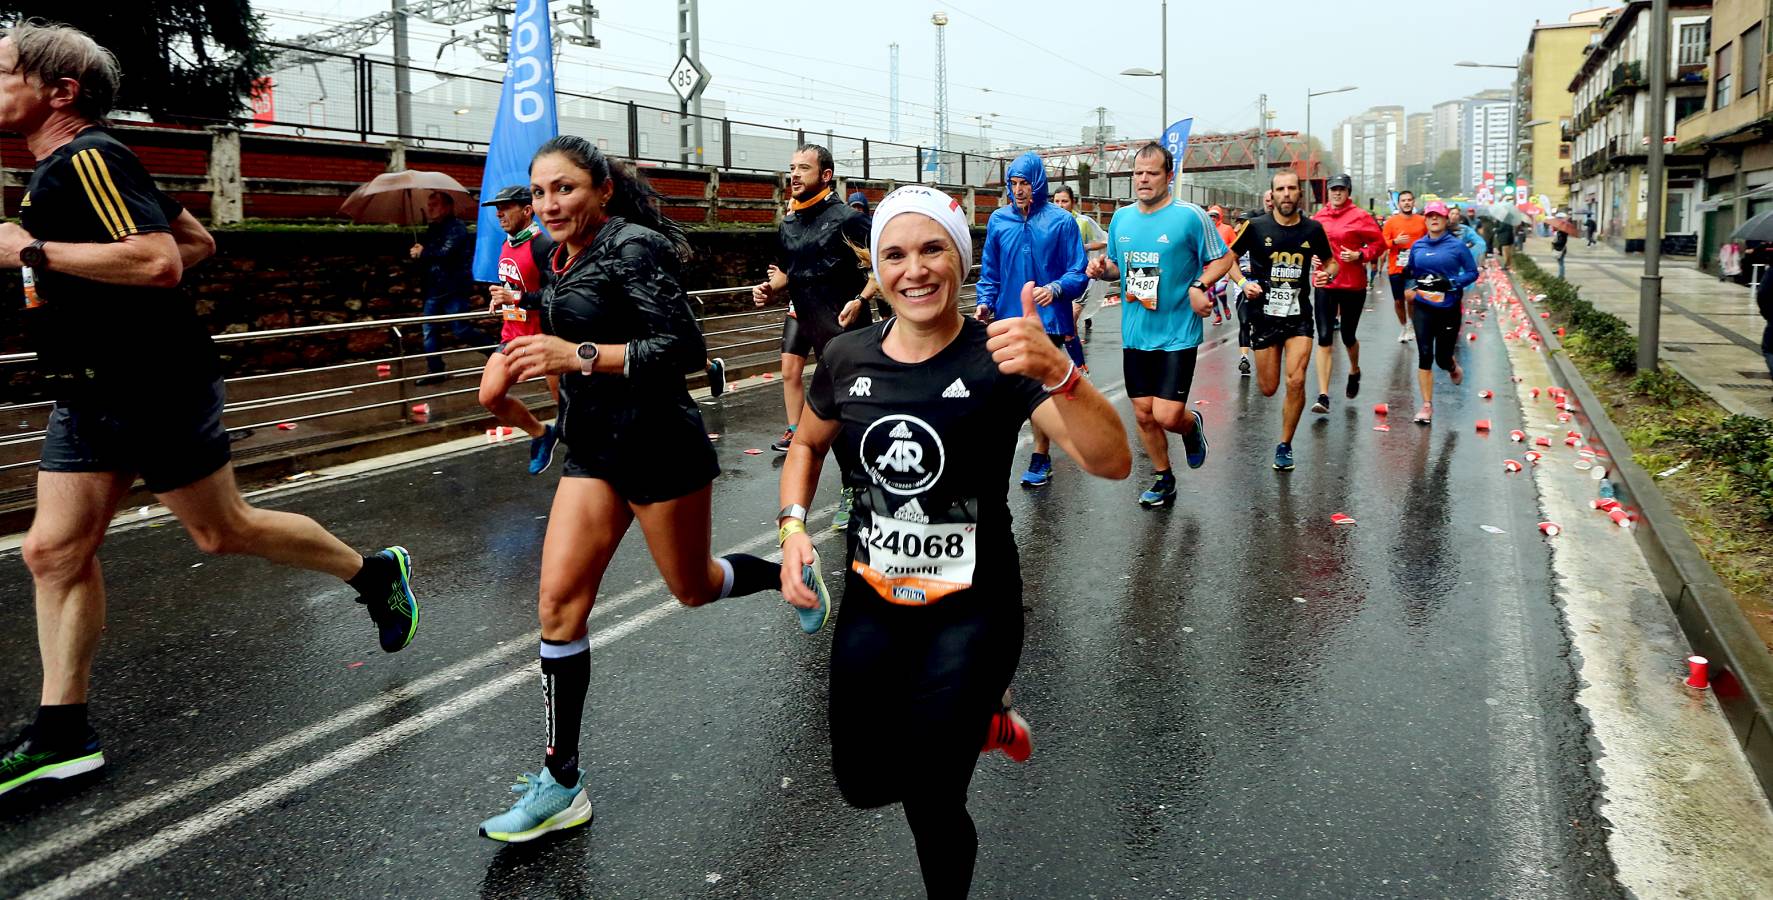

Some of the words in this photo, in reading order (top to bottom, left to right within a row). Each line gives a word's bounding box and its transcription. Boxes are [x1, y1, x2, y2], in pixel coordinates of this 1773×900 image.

[678, 69, 691, 87] 85
[1269, 251, 1304, 267] 100
[875, 440, 926, 474] AR
[894, 508, 930, 524] adidas
[869, 523, 964, 558] 24068
